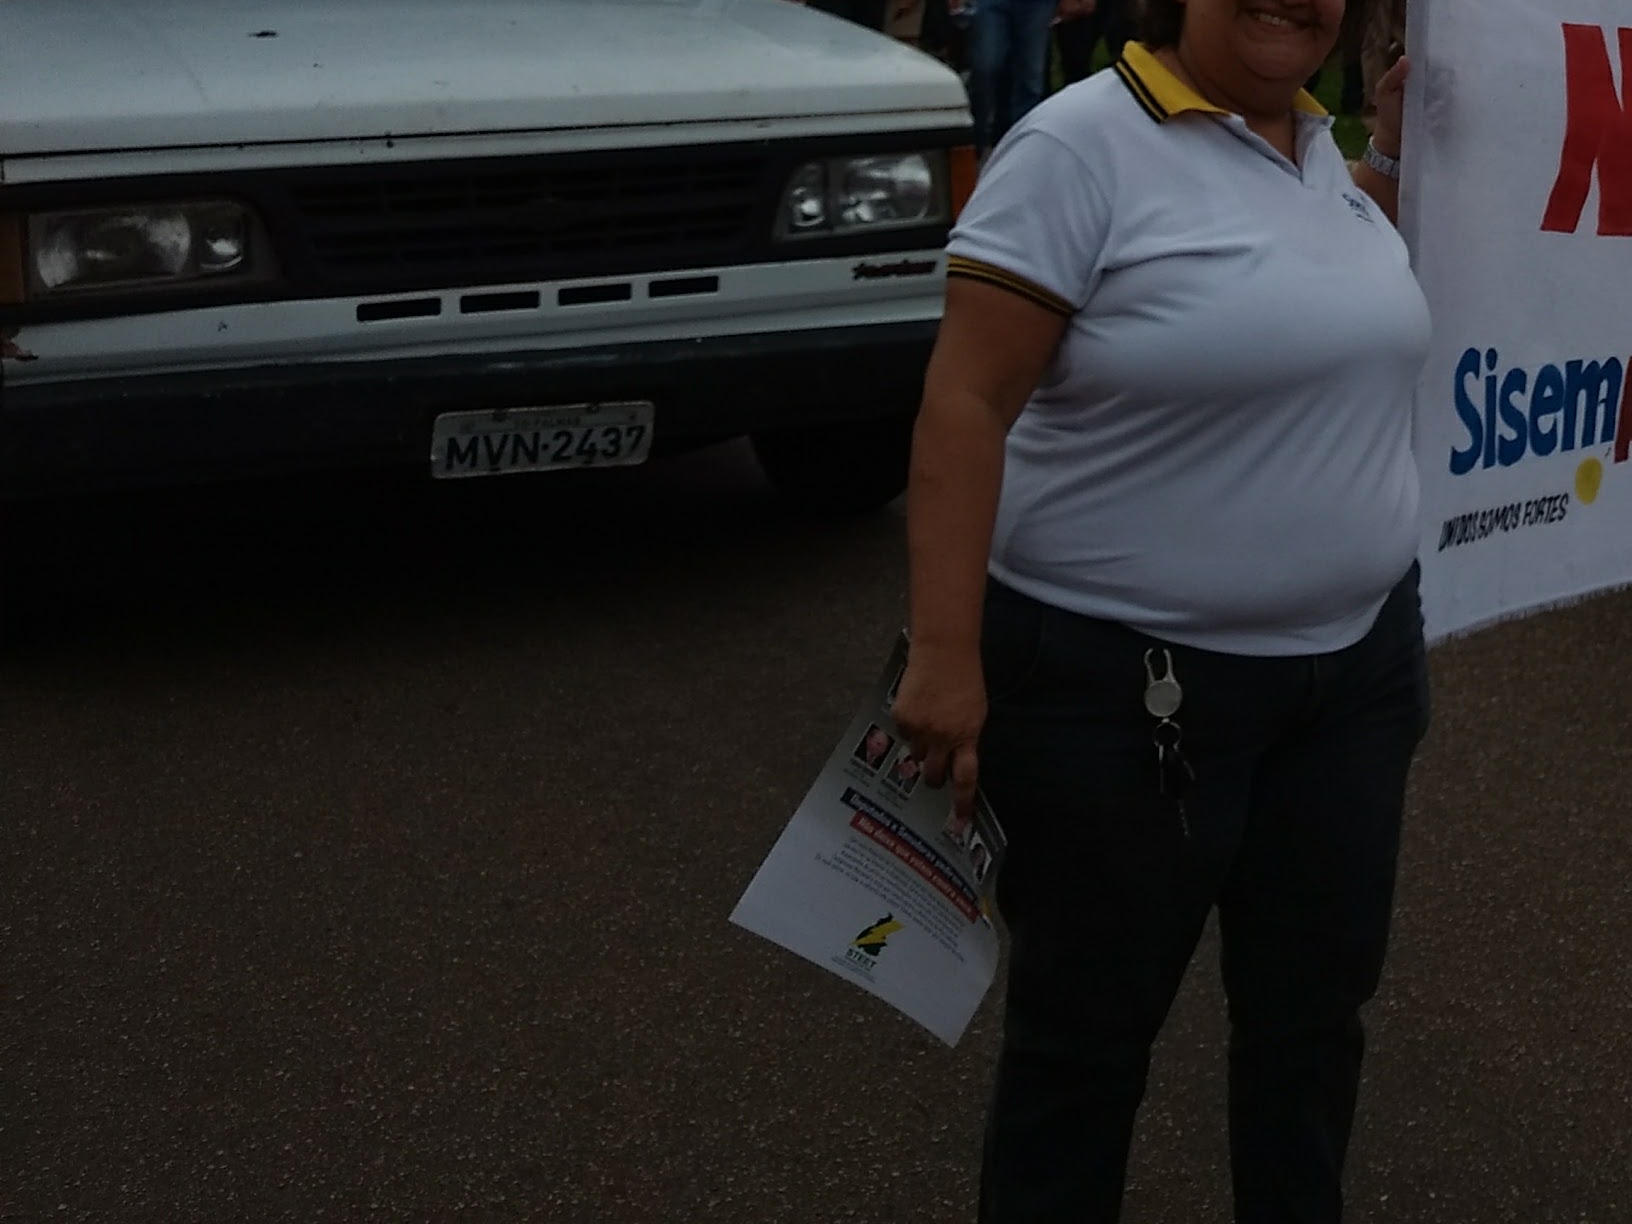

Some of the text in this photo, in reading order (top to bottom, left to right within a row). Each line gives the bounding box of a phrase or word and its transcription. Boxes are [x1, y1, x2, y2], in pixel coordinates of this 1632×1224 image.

[1438, 493, 1569, 552] UNIDOS SOMOS FORTES
